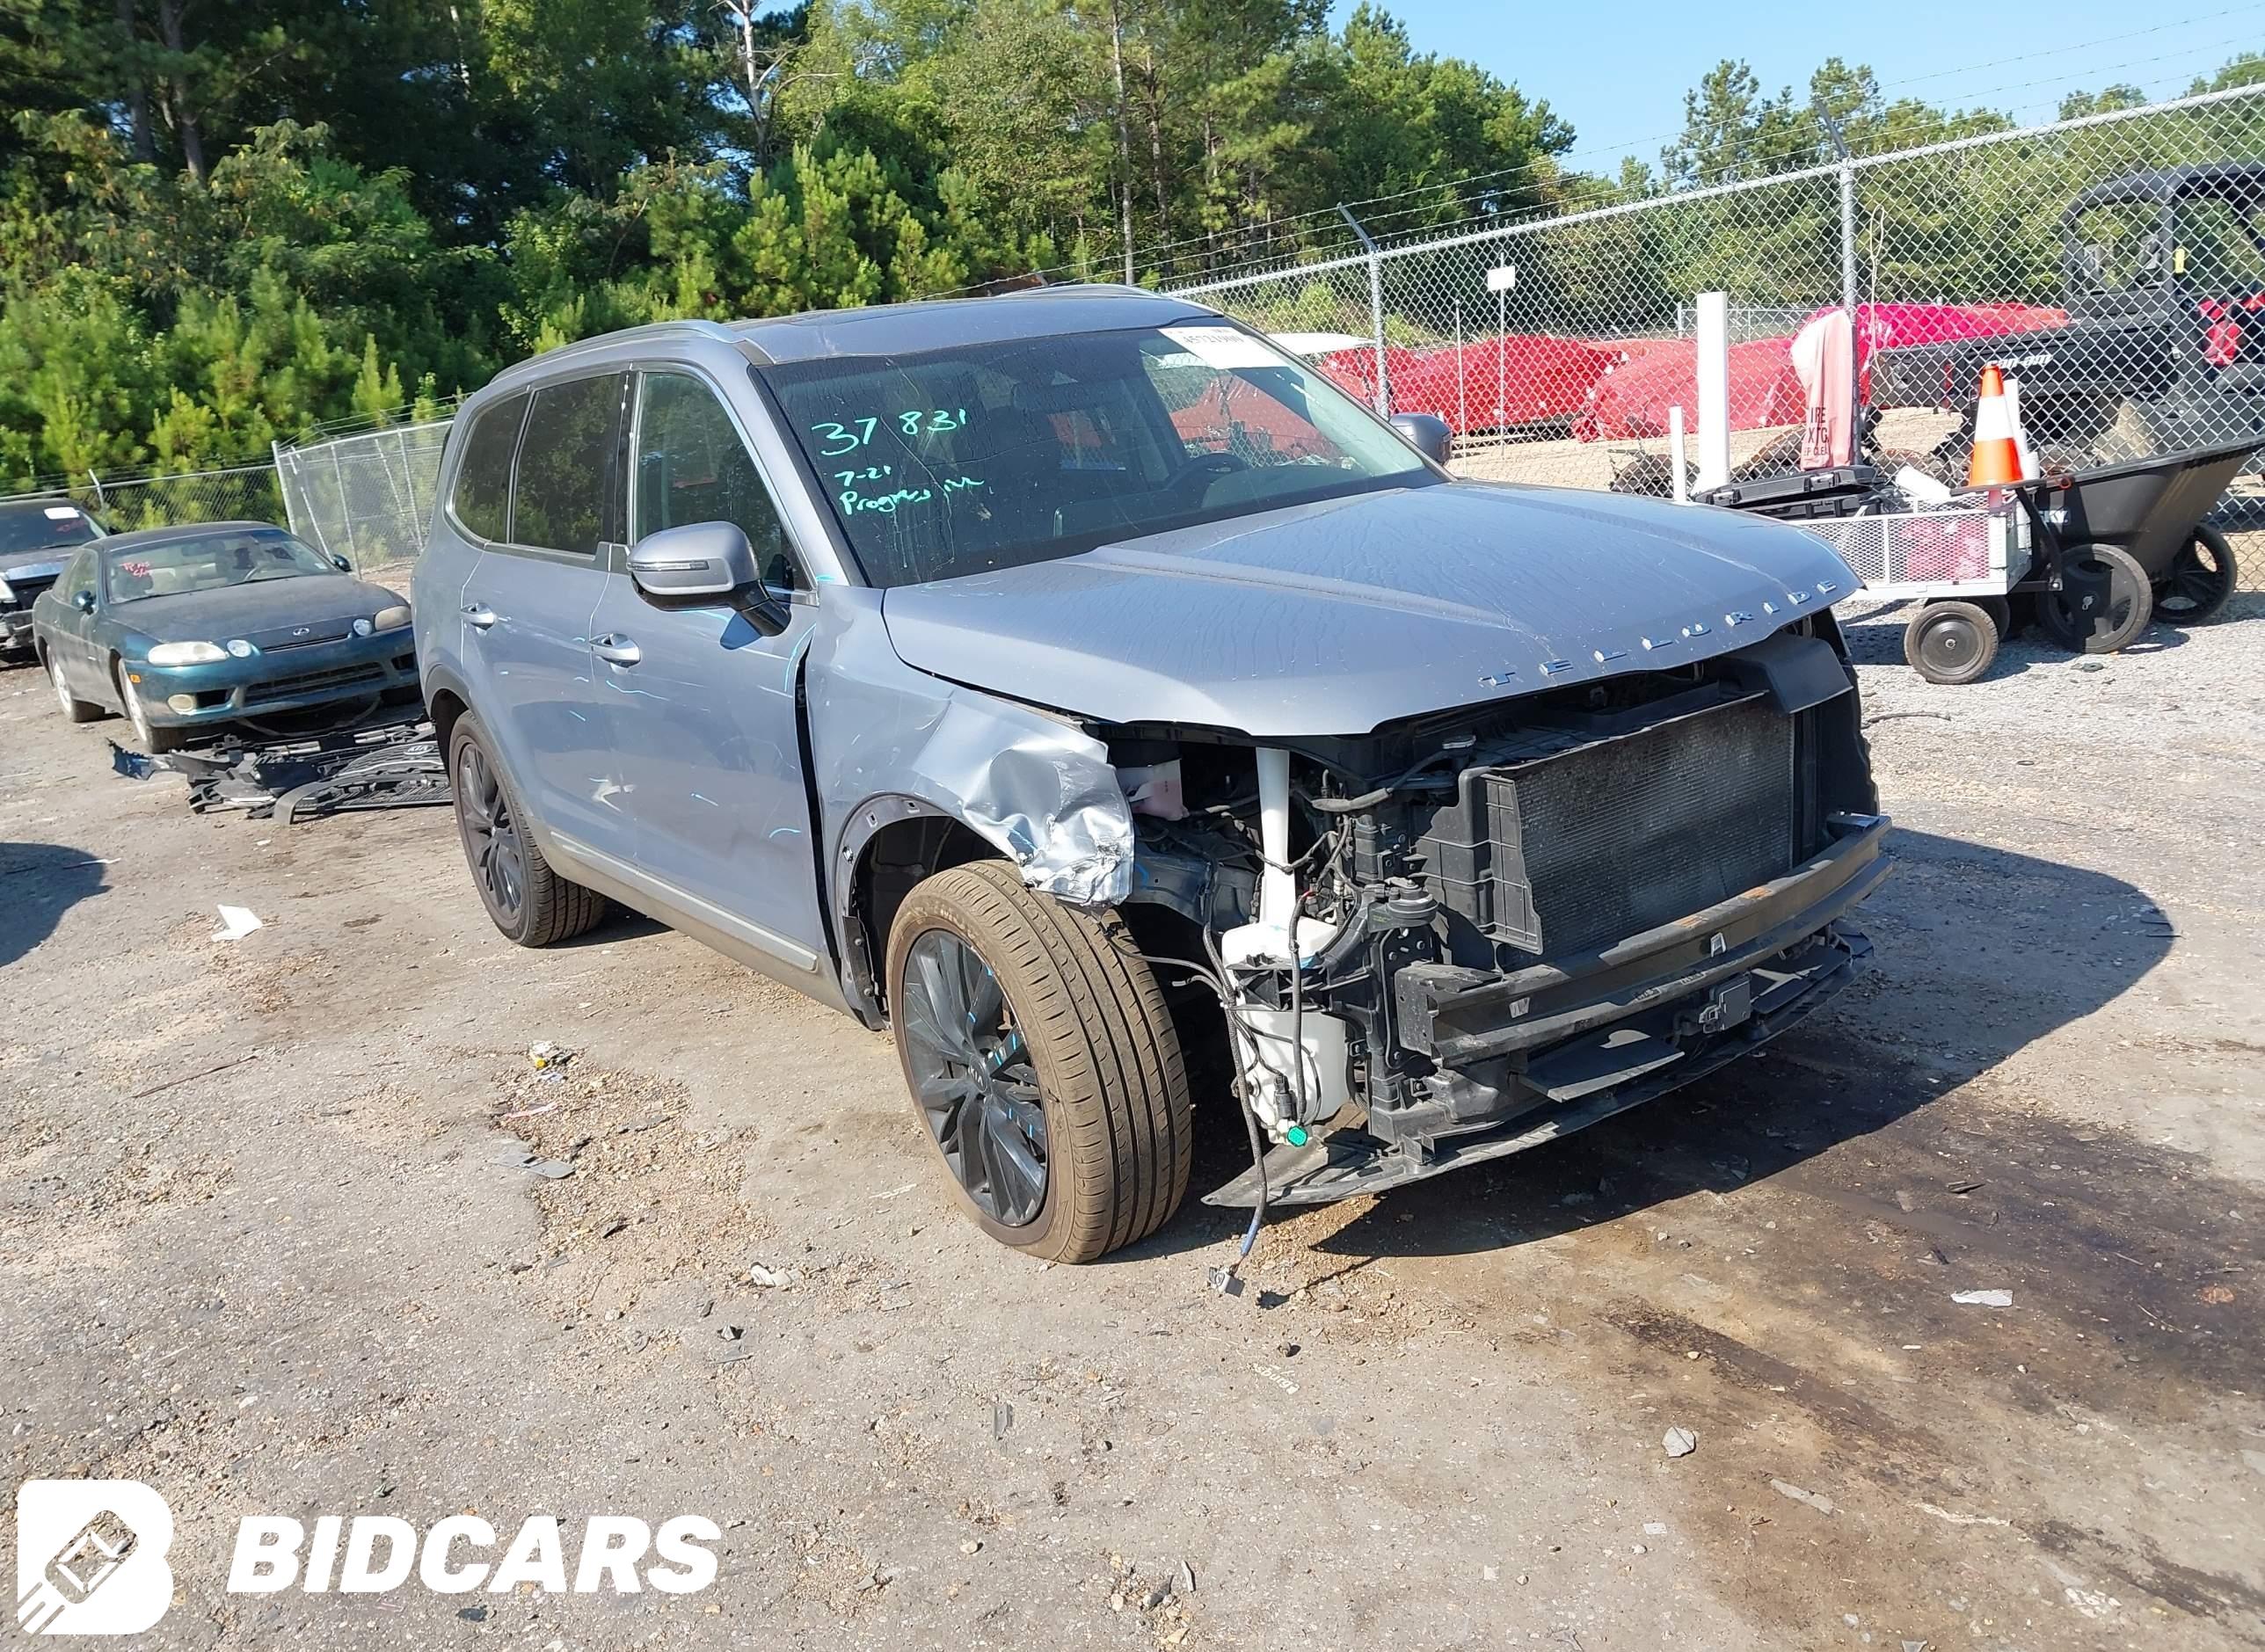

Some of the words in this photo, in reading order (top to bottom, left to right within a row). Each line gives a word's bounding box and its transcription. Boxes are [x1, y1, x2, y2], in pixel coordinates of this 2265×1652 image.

[812, 418, 878, 456] 37
[899, 409, 966, 434] 831
[1810, 407, 1826, 423] IRE
[1479, 579, 1838, 687] TELLURIDE
